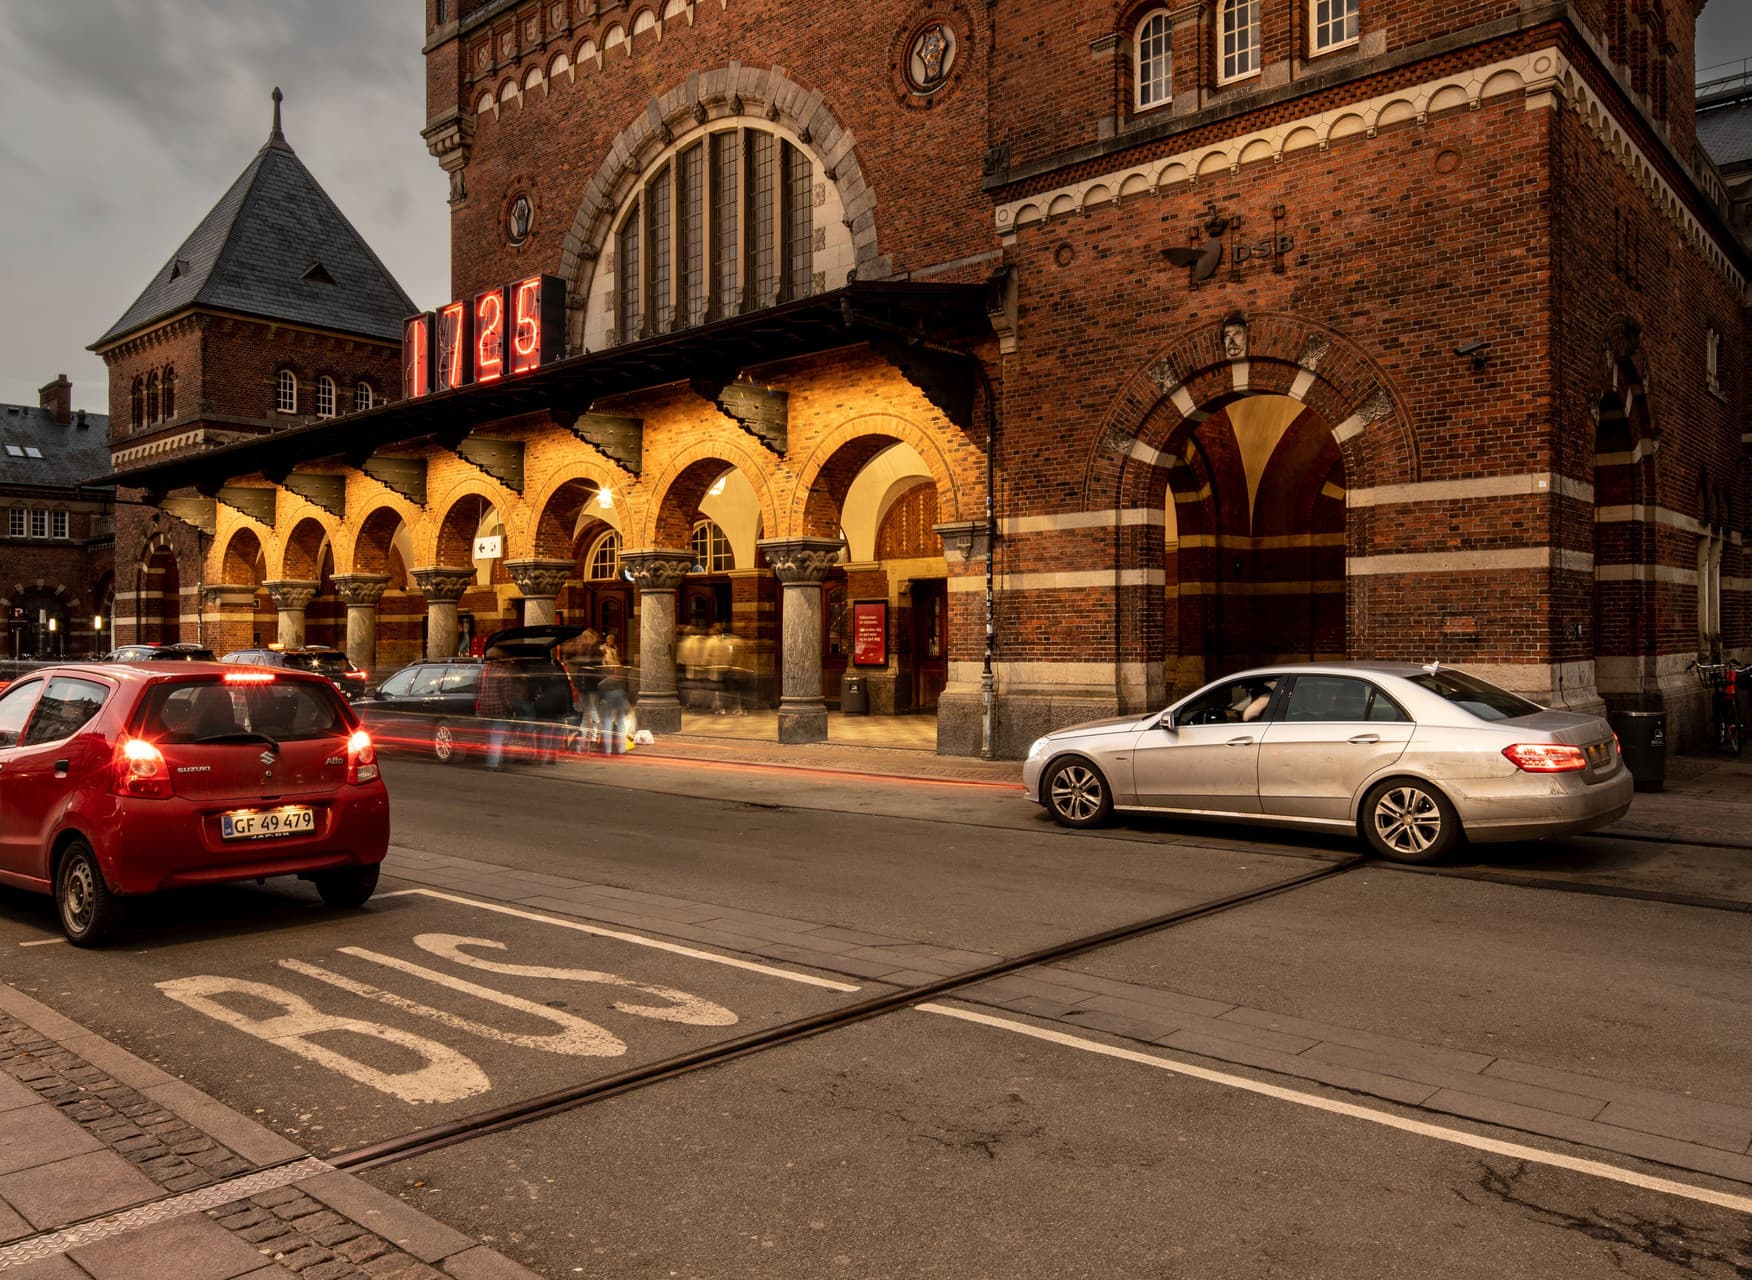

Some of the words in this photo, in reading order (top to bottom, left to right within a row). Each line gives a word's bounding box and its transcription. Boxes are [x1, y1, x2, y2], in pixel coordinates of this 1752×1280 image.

[1233, 234, 1295, 263] DSB
[177, 765, 211, 774] SUZUKI
[234, 817, 255, 834] GF
[260, 815, 279, 831] 49
[283, 812, 312, 829] 479
[153, 933, 739, 1104] BUS
